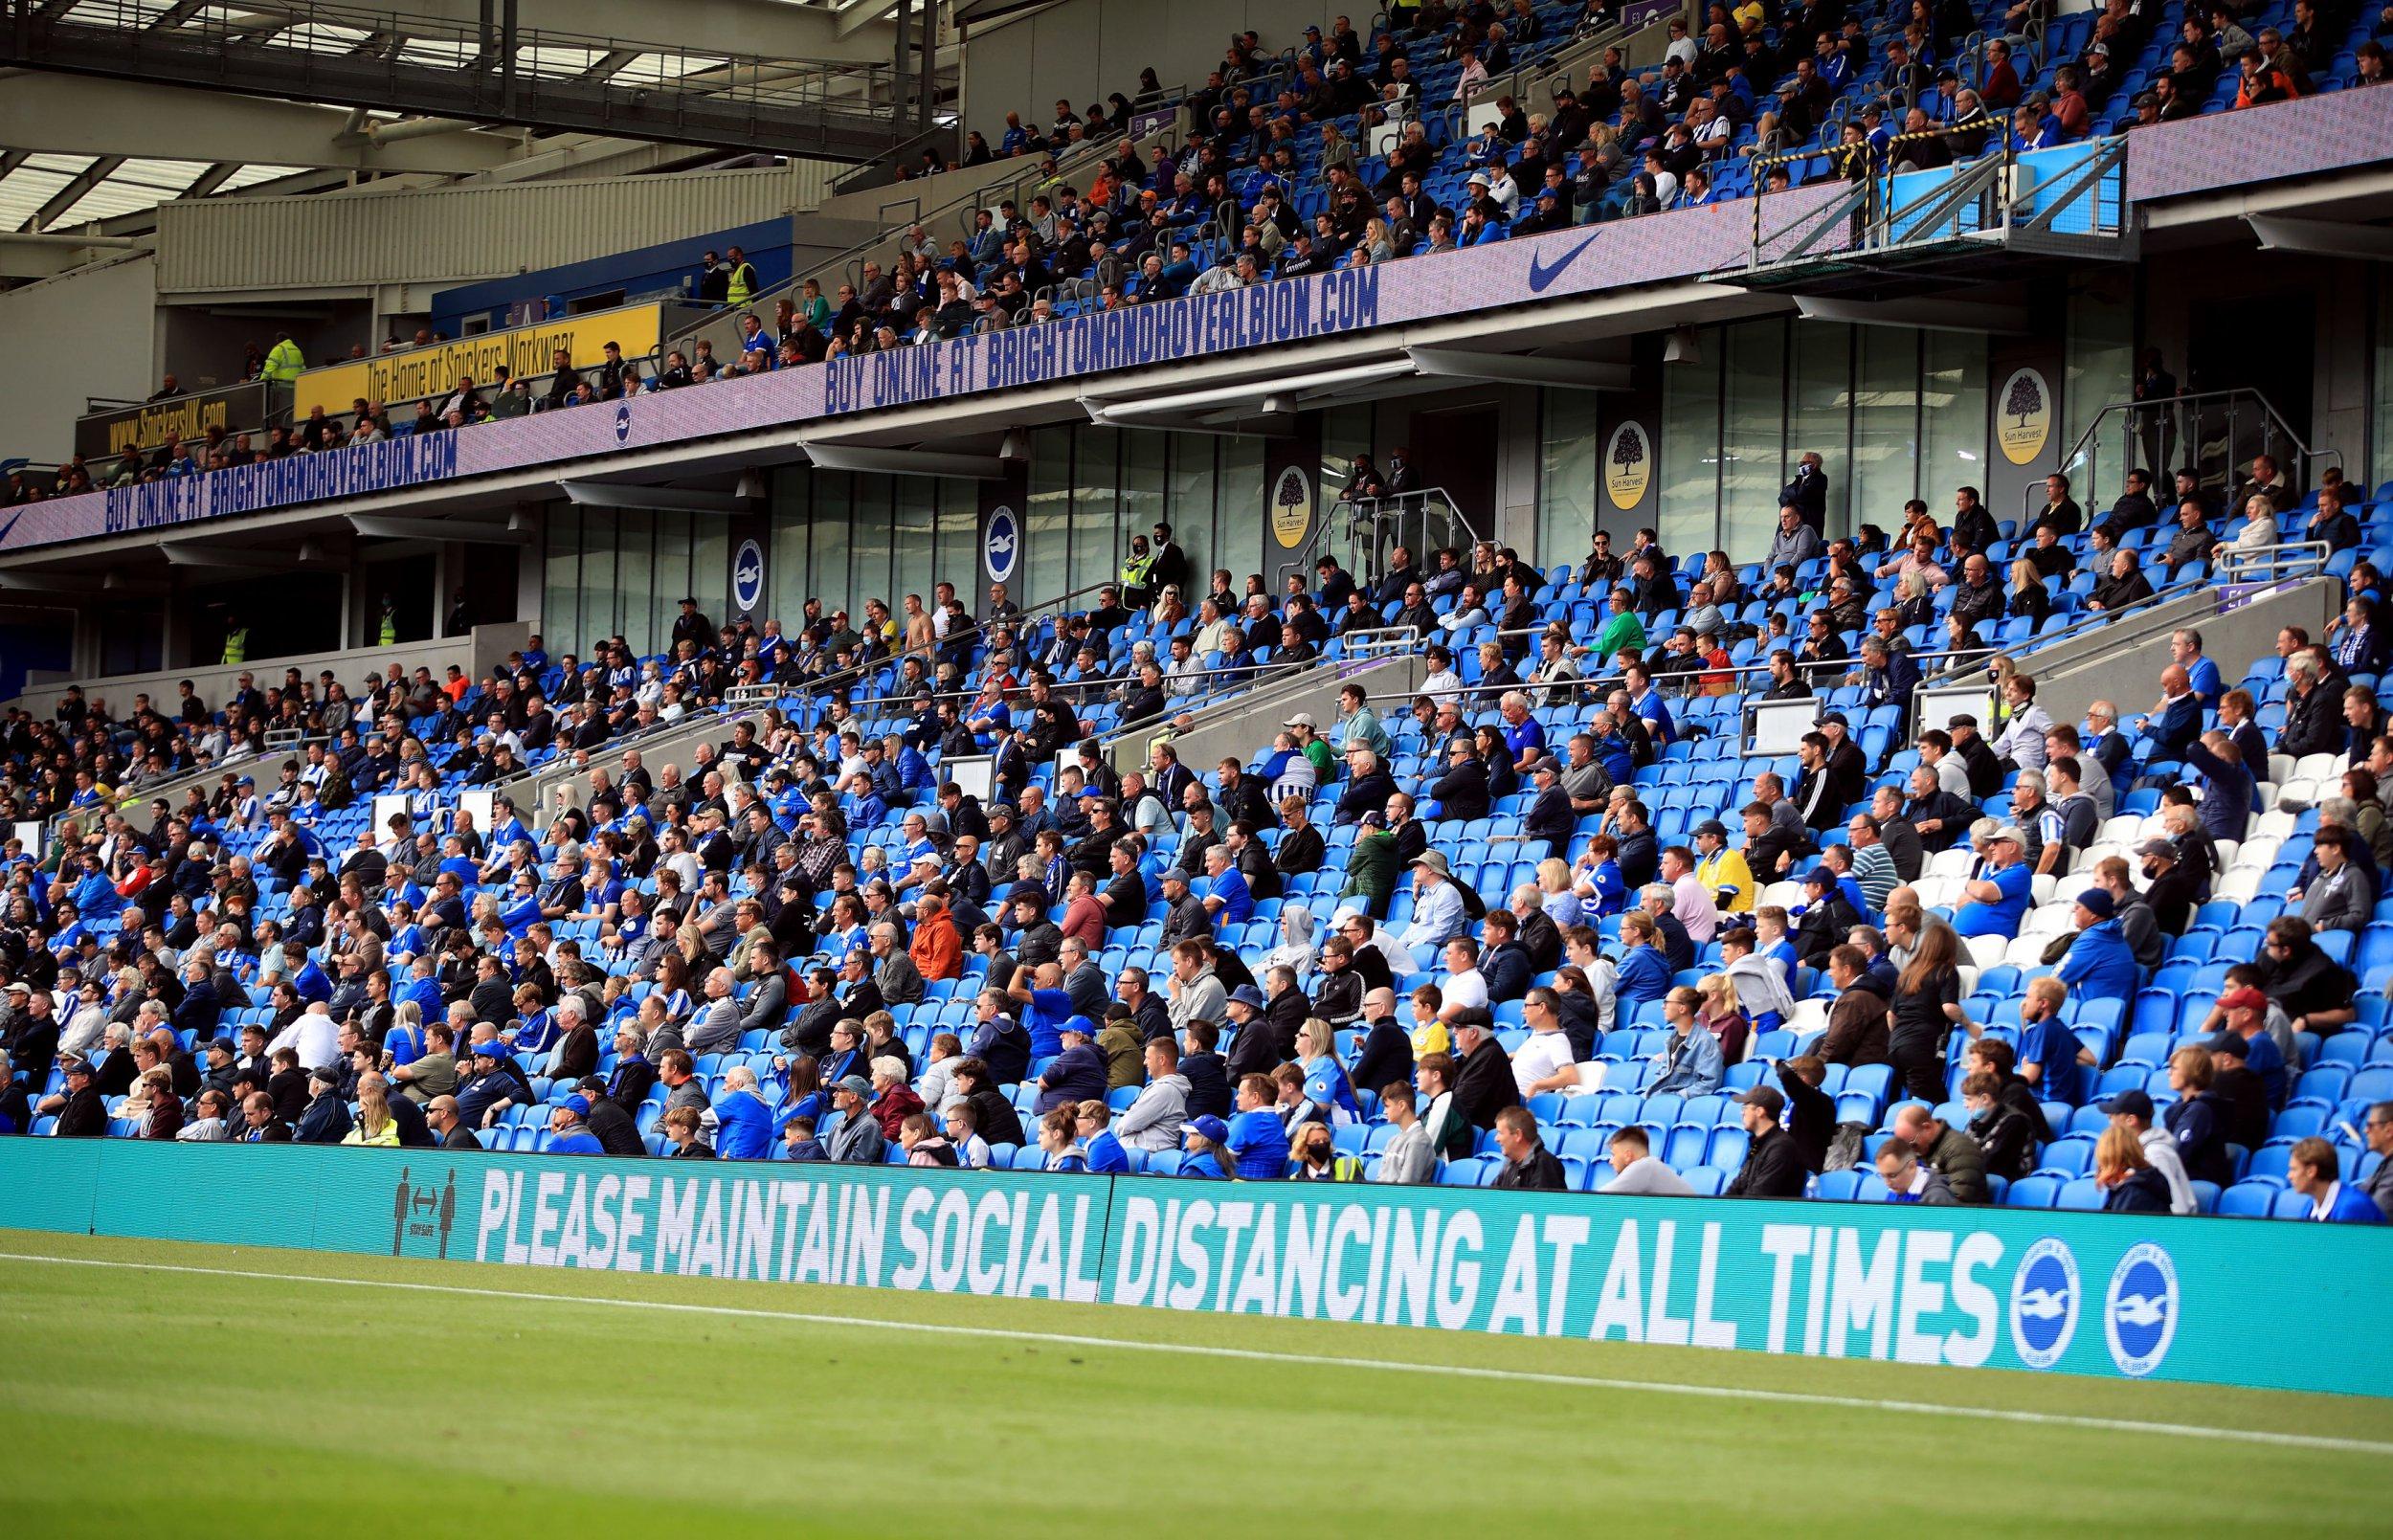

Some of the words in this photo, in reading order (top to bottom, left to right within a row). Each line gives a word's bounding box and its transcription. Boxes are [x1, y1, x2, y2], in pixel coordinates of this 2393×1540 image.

[825, 355, 865, 414] BUY
[874, 342, 943, 407] ONLINE
[950, 337, 979, 395] AT
[987, 264, 1378, 389] BRIGHTONANDHOVEALBION.COM
[368, 362, 387, 404] The
[391, 357, 426, 401] Home
[431, 348, 444, 393] of
[446, 338, 502, 391] Snickers
[110, 398, 226, 455] www.SnickersUK.com
[2004, 432, 2017, 441] Sun
[2017, 429, 2042, 440] Harvest
[106, 486, 132, 533] BUY
[138, 476, 183, 526] ONLINE
[187, 472, 207, 520] AT
[210, 429, 458, 517] BRIGHTONANDHOVEALBION.COM
[1611, 480, 1621, 488] Sun
[1622, 477, 1644, 487] Harvest
[1277, 520, 1286, 528] Sun
[1286, 519, 1305, 527] Harvest
[2228, 590, 2242, 608] E1
[476, 1168, 651, 1271] PLEASE
[654, 1177, 891, 1288] MAINTAIN
[891, 1186, 1098, 1304] SOCIAL
[1113, 1196, 1483, 1330] DISTANCING
[1487, 1213, 1591, 1337] AT
[1588, 1218, 1736, 1350] ALL
[1761, 1224, 2004, 1368] TIMES
